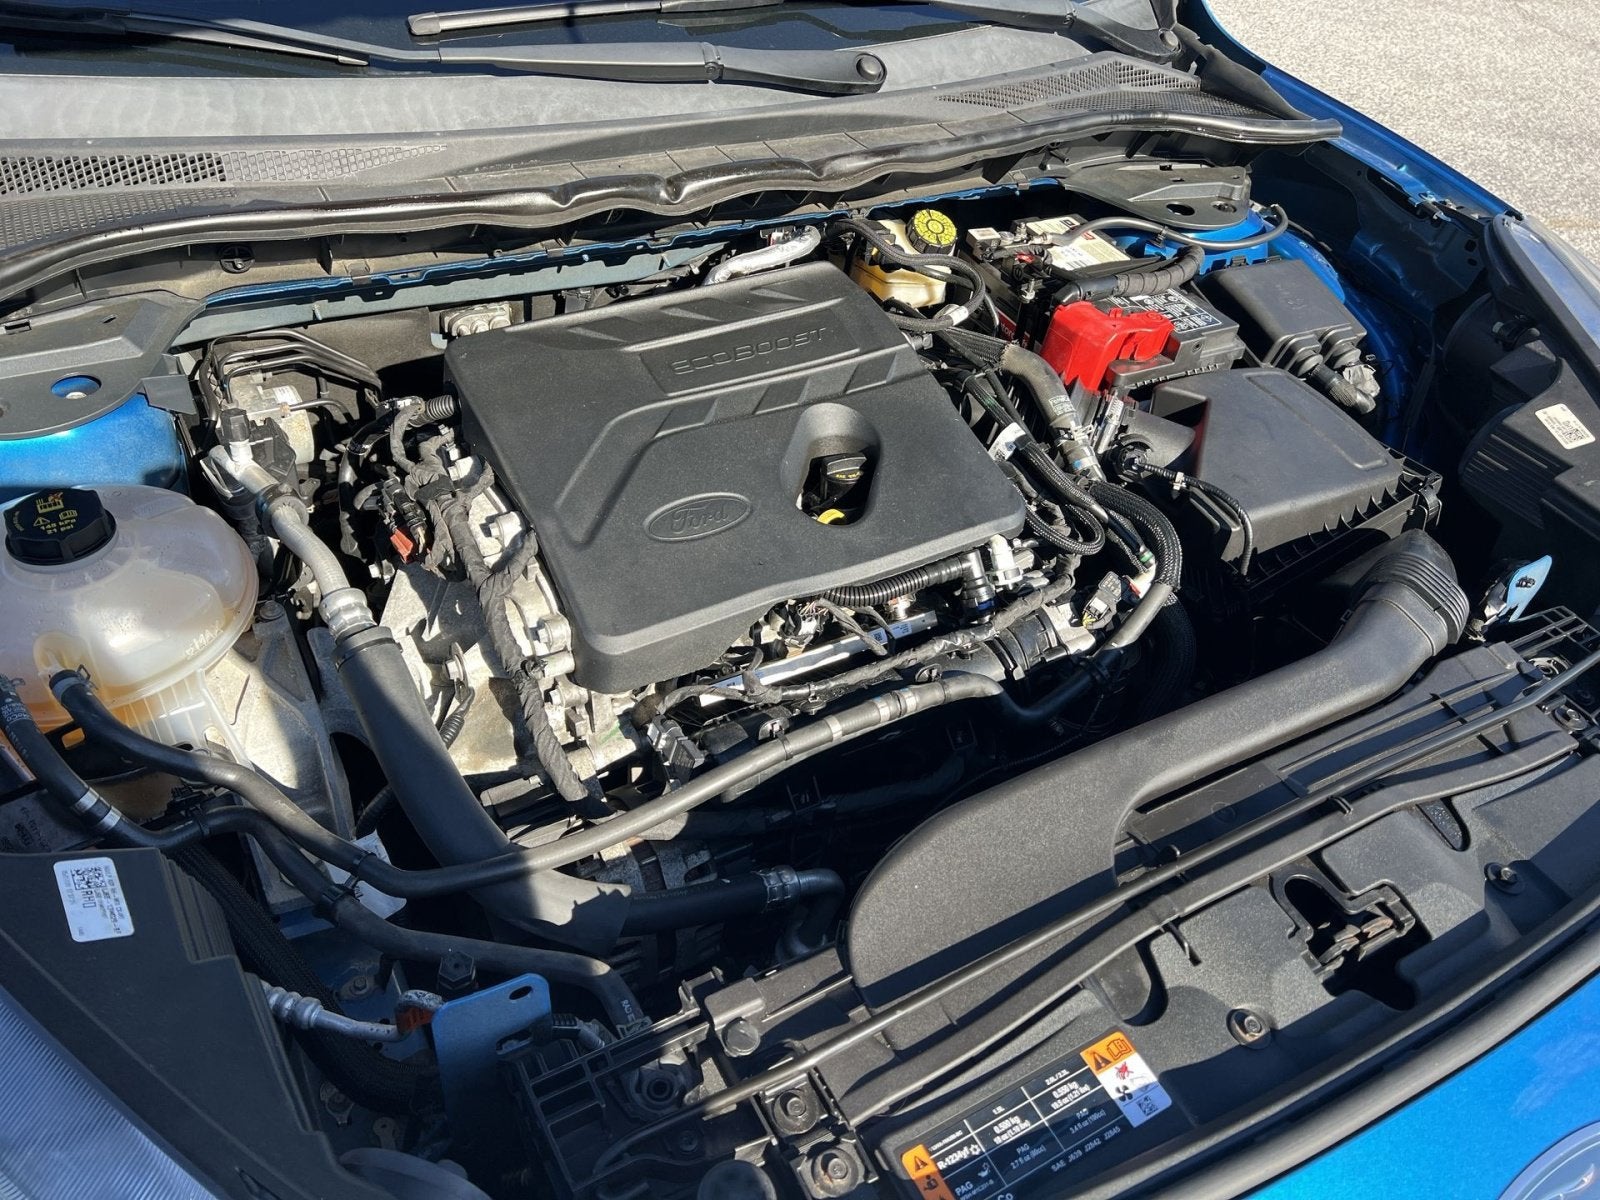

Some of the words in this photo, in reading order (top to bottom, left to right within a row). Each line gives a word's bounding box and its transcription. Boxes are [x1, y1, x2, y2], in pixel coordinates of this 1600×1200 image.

[671, 328, 827, 375] ECOBOOST
[671, 501, 729, 535] Ford
[1076, 1108, 1089, 1119] PAG
[1016, 1143, 1030, 1155] PAG
[1051, 1160, 1066, 1172] SAE
[955, 1181, 973, 1196] PAG
